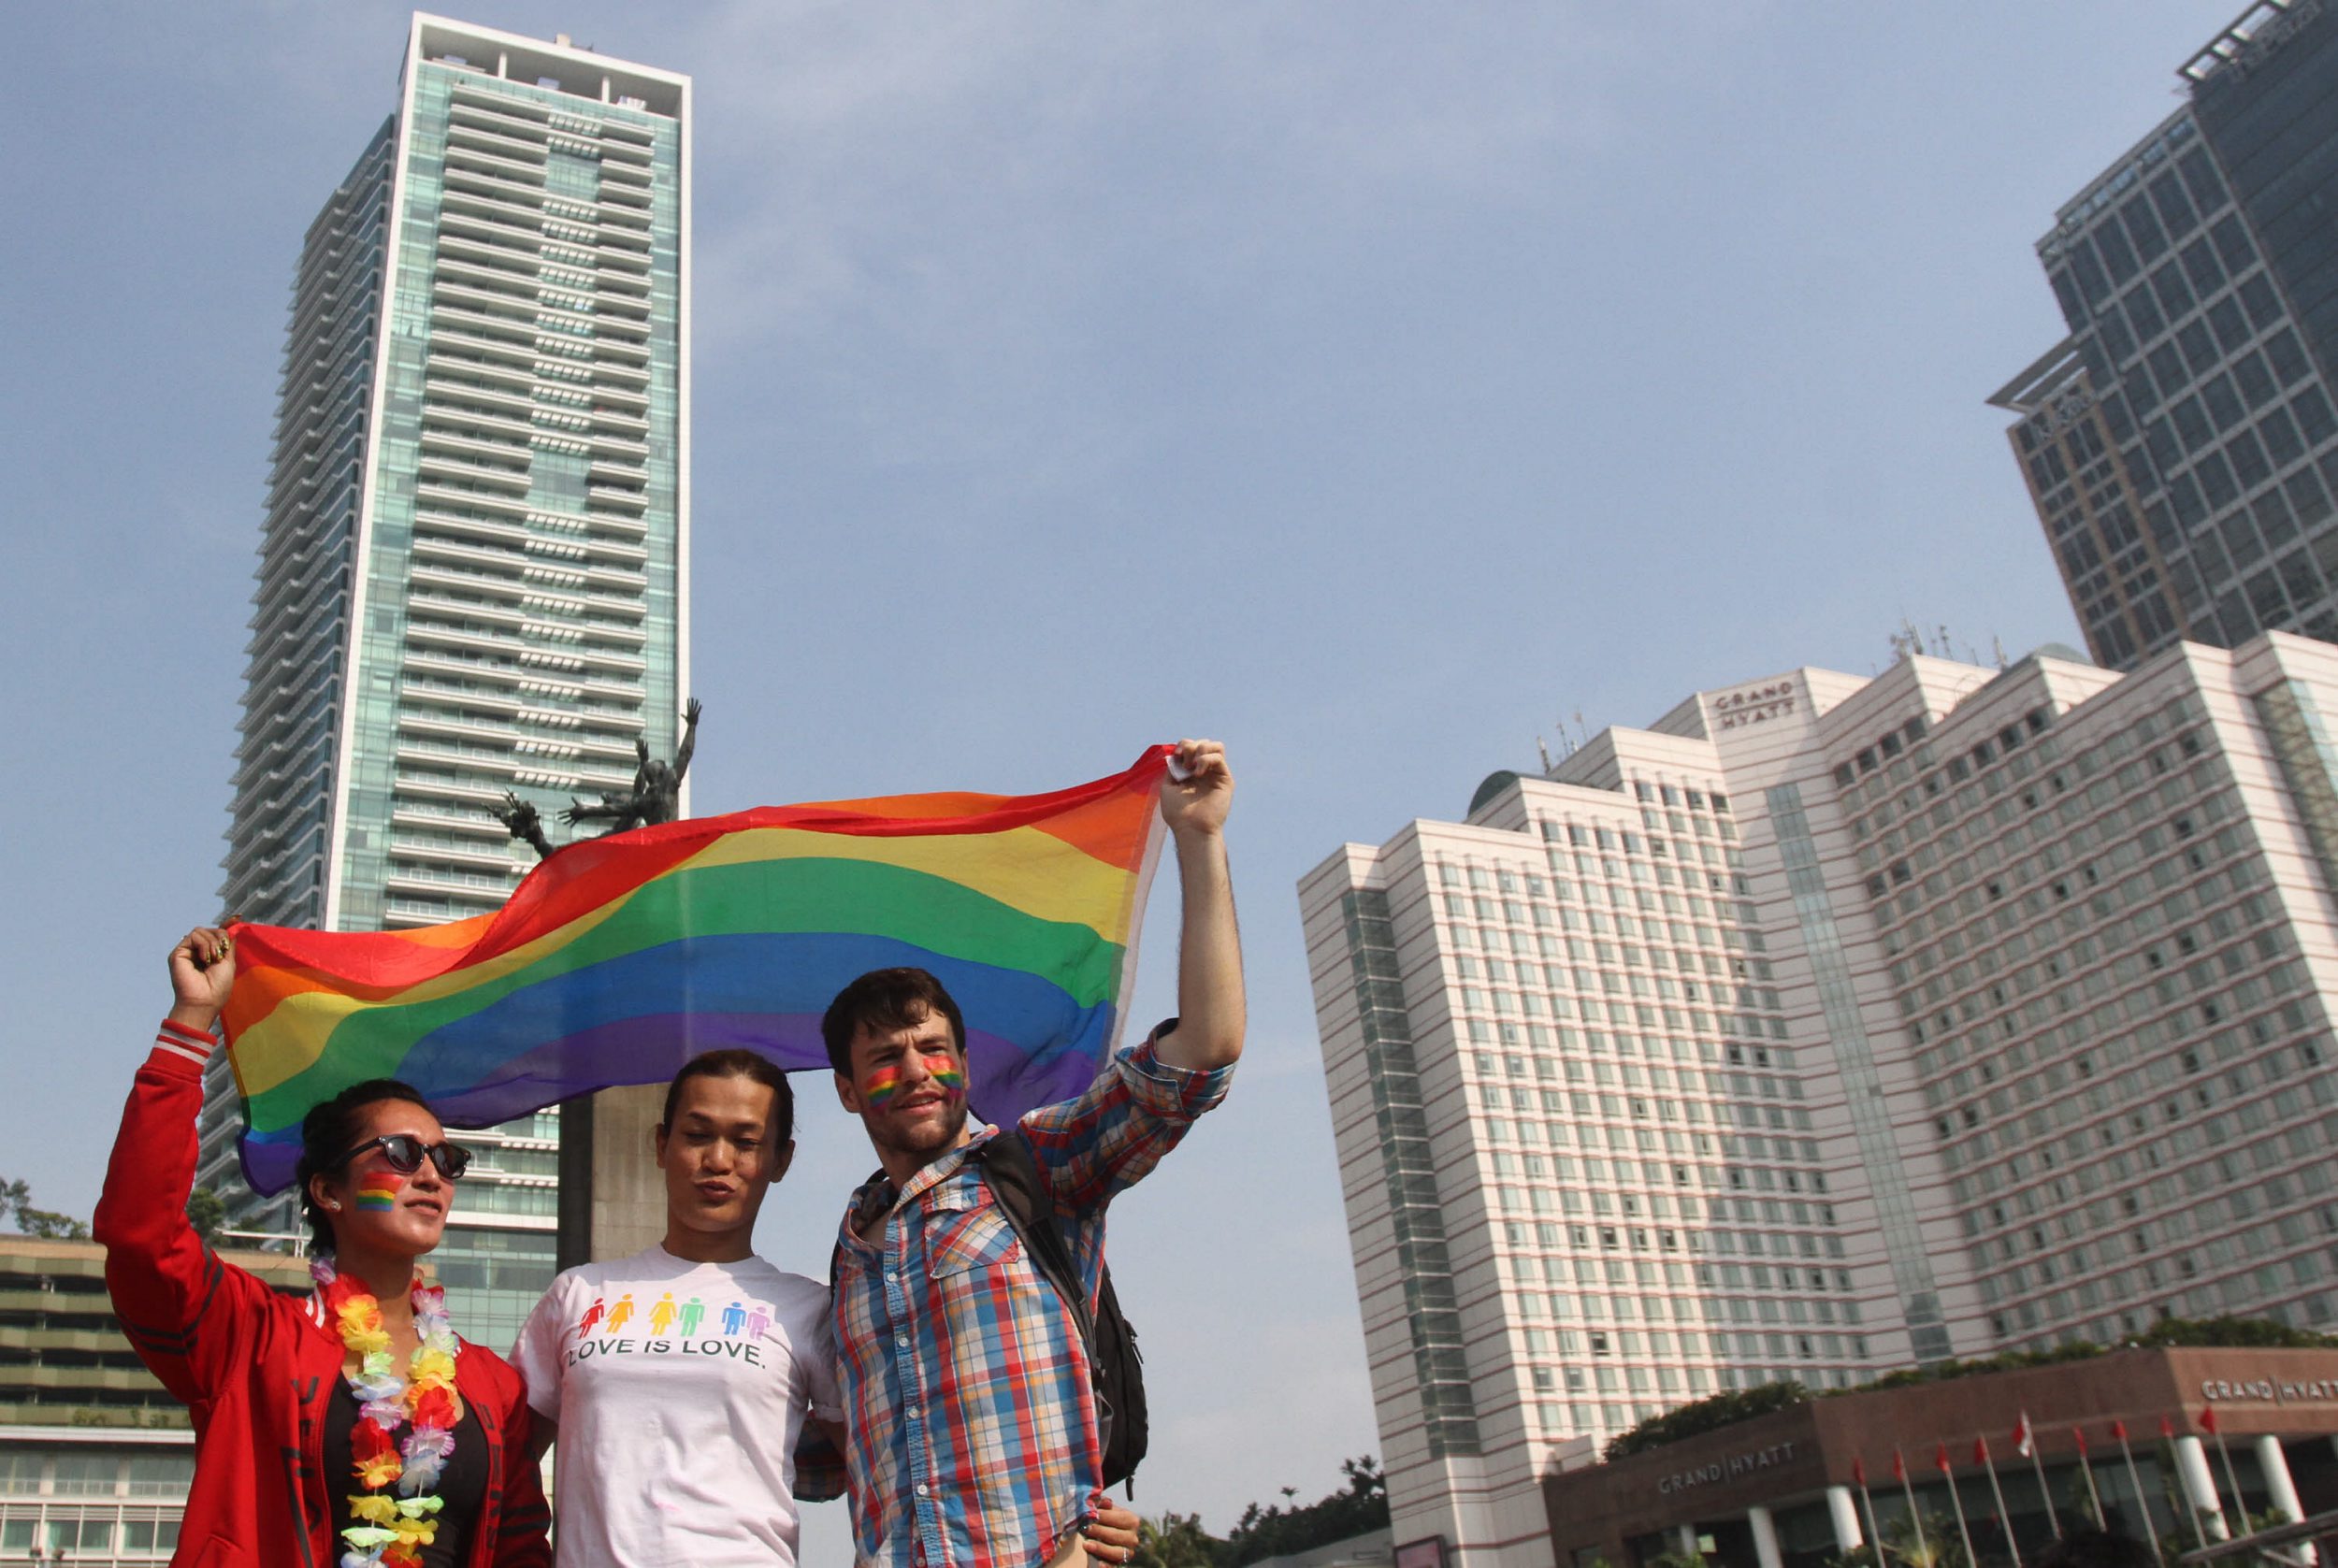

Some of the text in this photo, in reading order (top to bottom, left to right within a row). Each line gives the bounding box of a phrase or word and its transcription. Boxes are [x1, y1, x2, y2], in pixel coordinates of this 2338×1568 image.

[1722, 699, 1794, 727] HYATT
[569, 1339, 766, 1369] LOVE IS LOVE.
[2201, 1379, 2273, 1400] GRAND
[1659, 1442, 1794, 1494] GRAND HYATT
